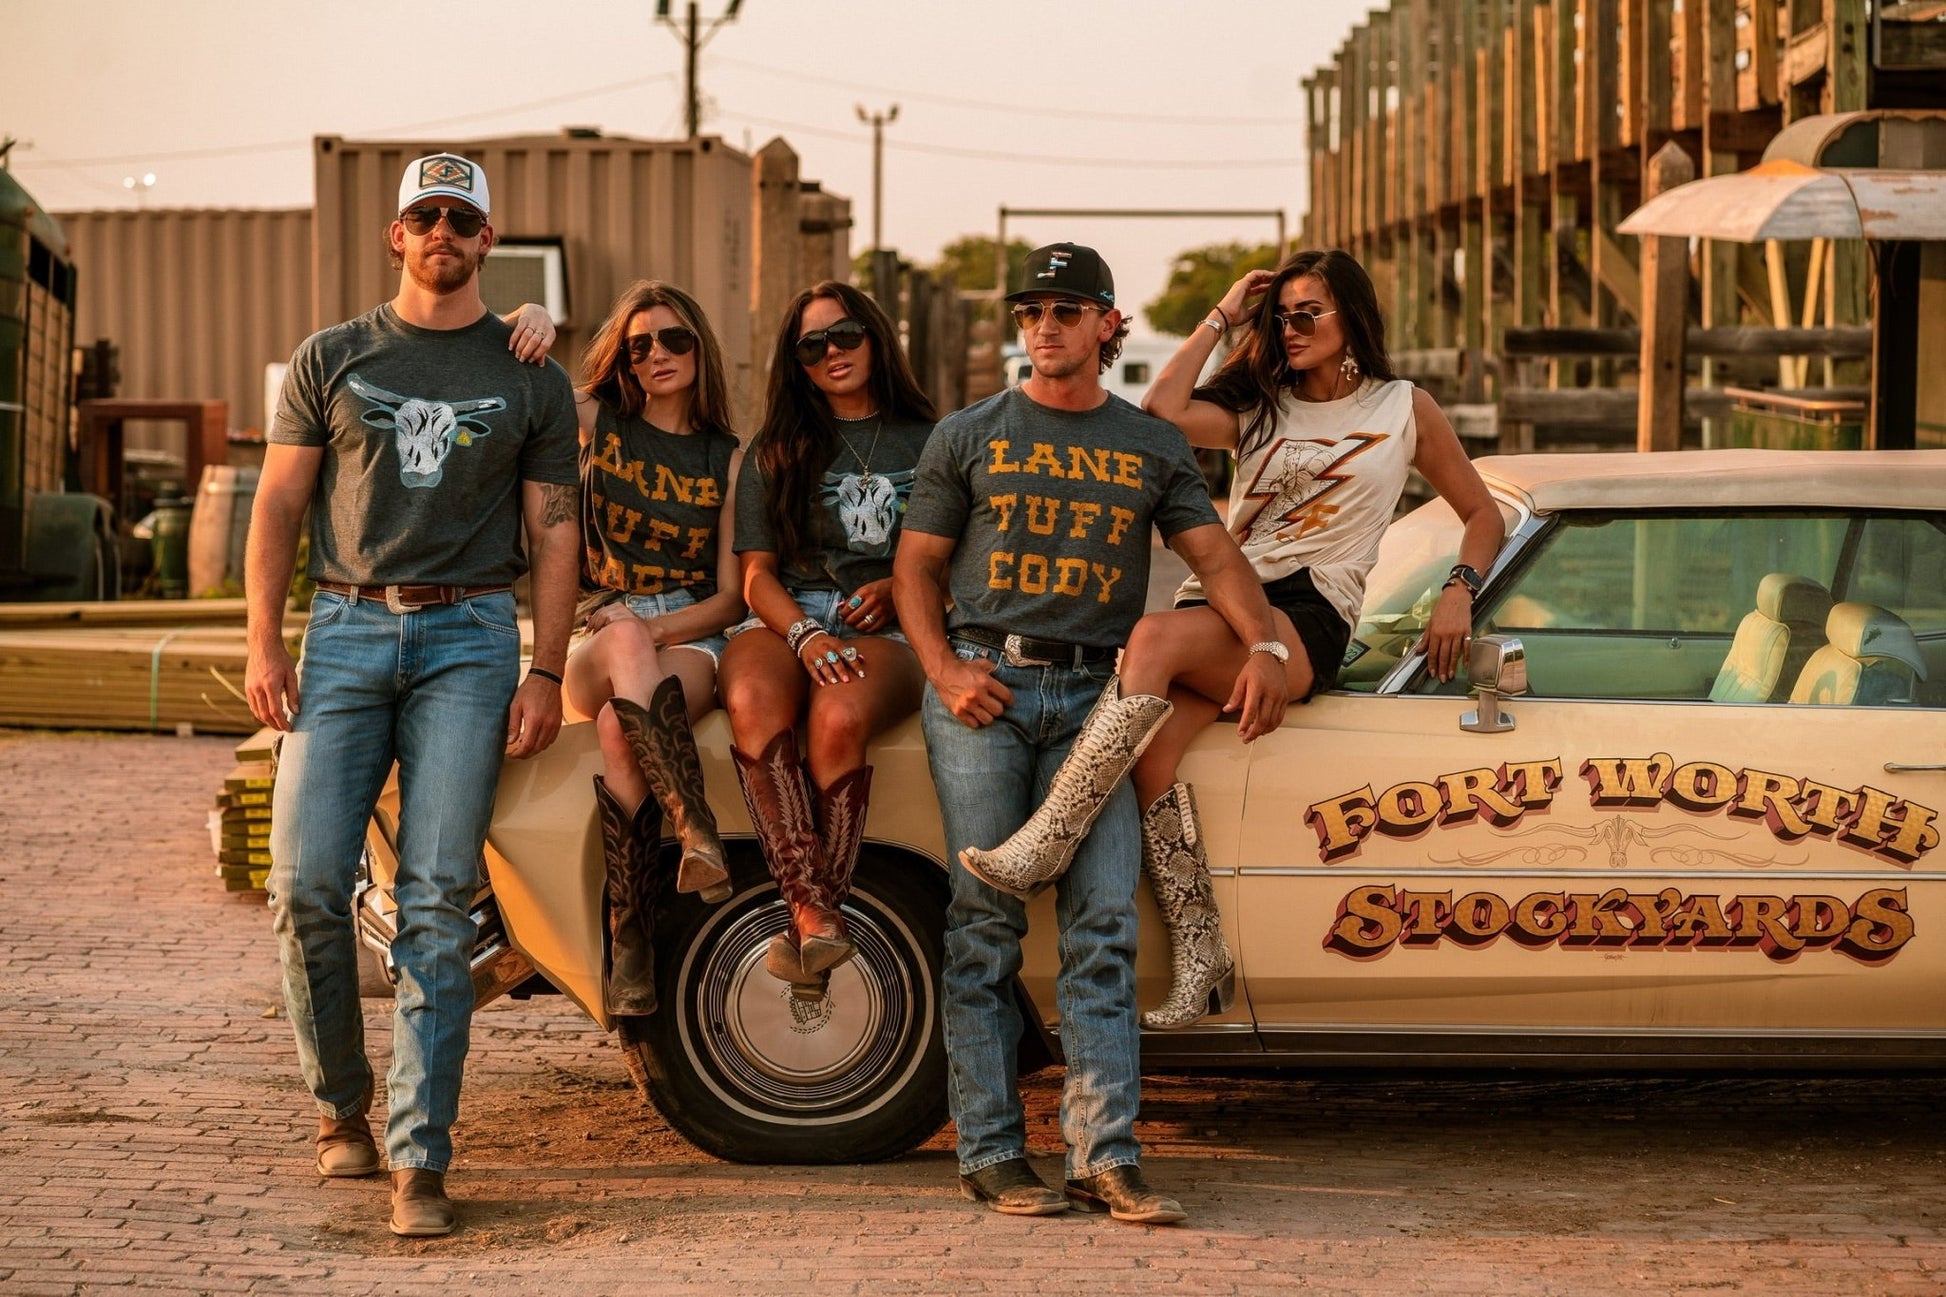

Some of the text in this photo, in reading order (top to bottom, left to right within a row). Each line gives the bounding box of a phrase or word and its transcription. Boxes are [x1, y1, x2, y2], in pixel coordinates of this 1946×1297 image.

[988, 439, 1143, 490] LANE
[988, 492, 1136, 546] TUFF
[988, 550, 1122, 604] CODY
[1304, 752, 1940, 869] FORT WORTH
[1323, 883, 1917, 965] STOCKYARDS
